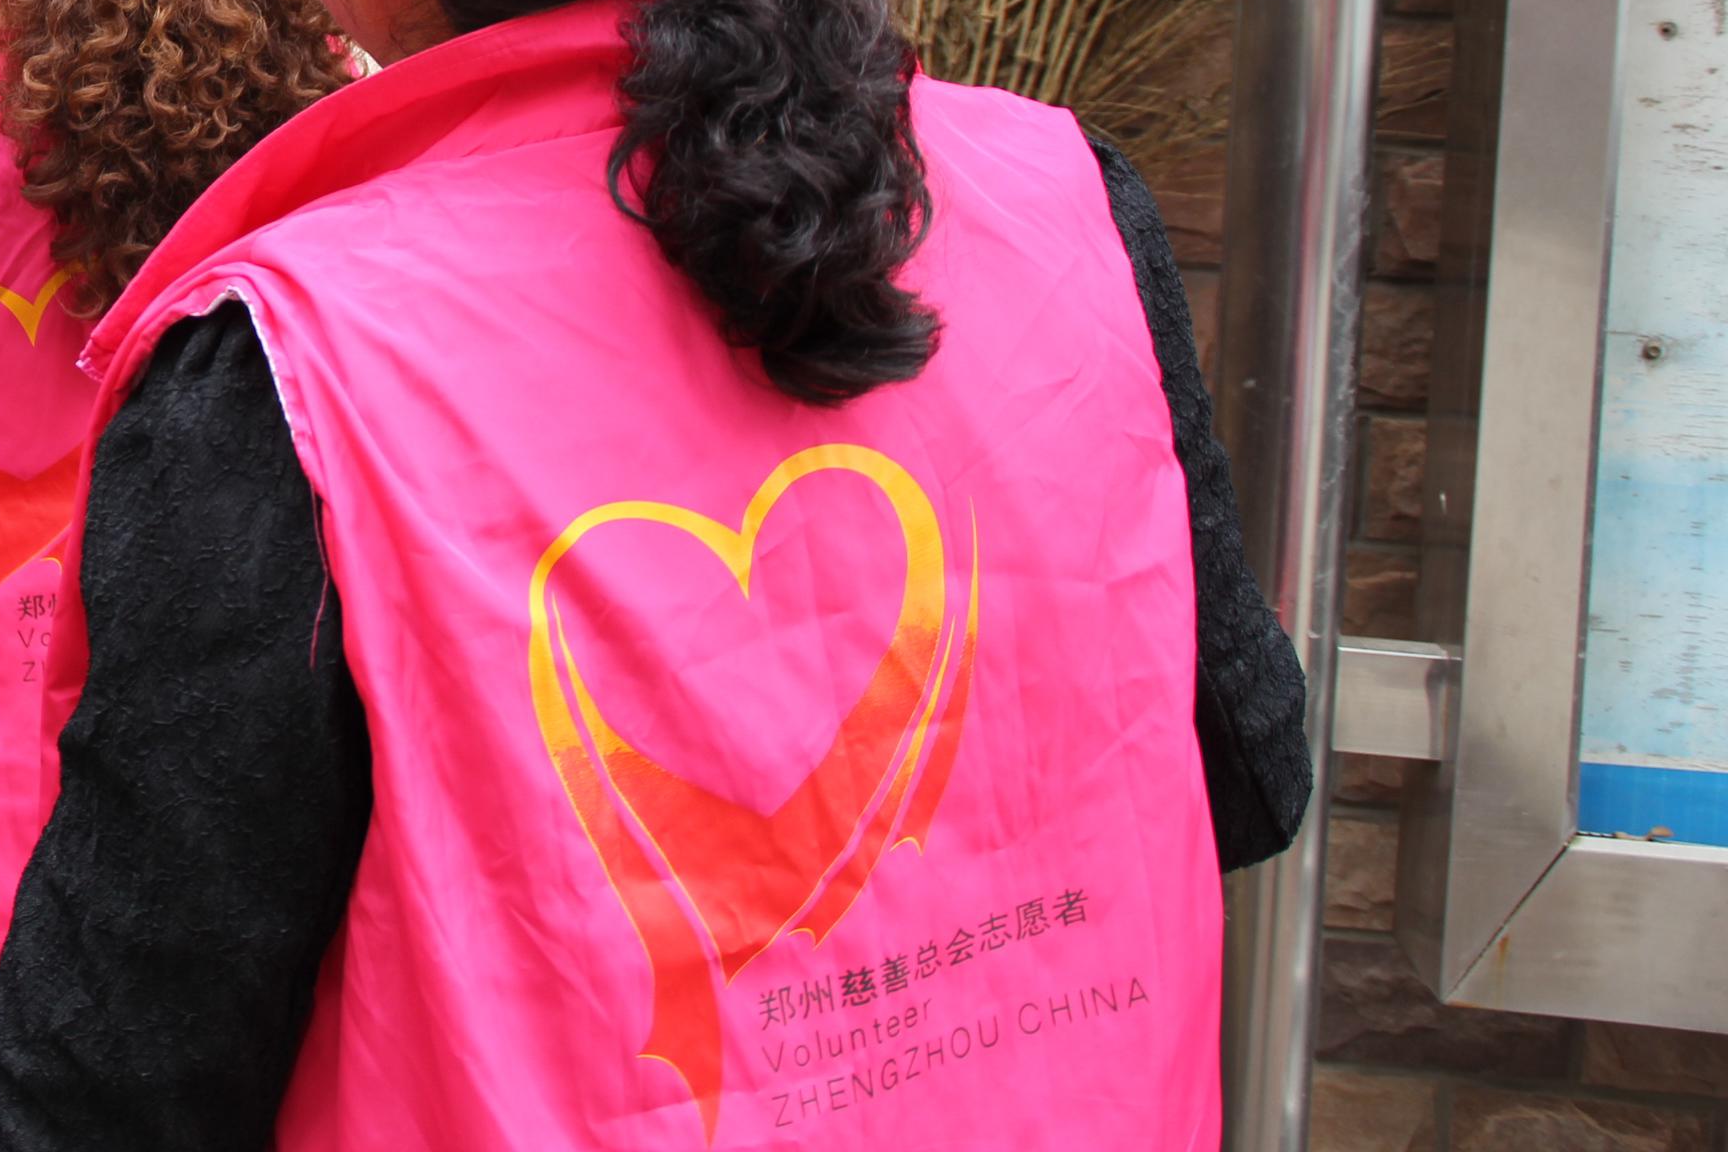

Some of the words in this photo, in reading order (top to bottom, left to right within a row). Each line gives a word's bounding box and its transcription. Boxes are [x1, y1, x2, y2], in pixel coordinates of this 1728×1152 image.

[759, 888, 1090, 1031] 郑州慈善总会志愿者
[762, 997, 934, 1074] Volunteer
[772, 1016, 1000, 1128] ZHENGZHOU
[1017, 976, 1150, 1036] CHINA
